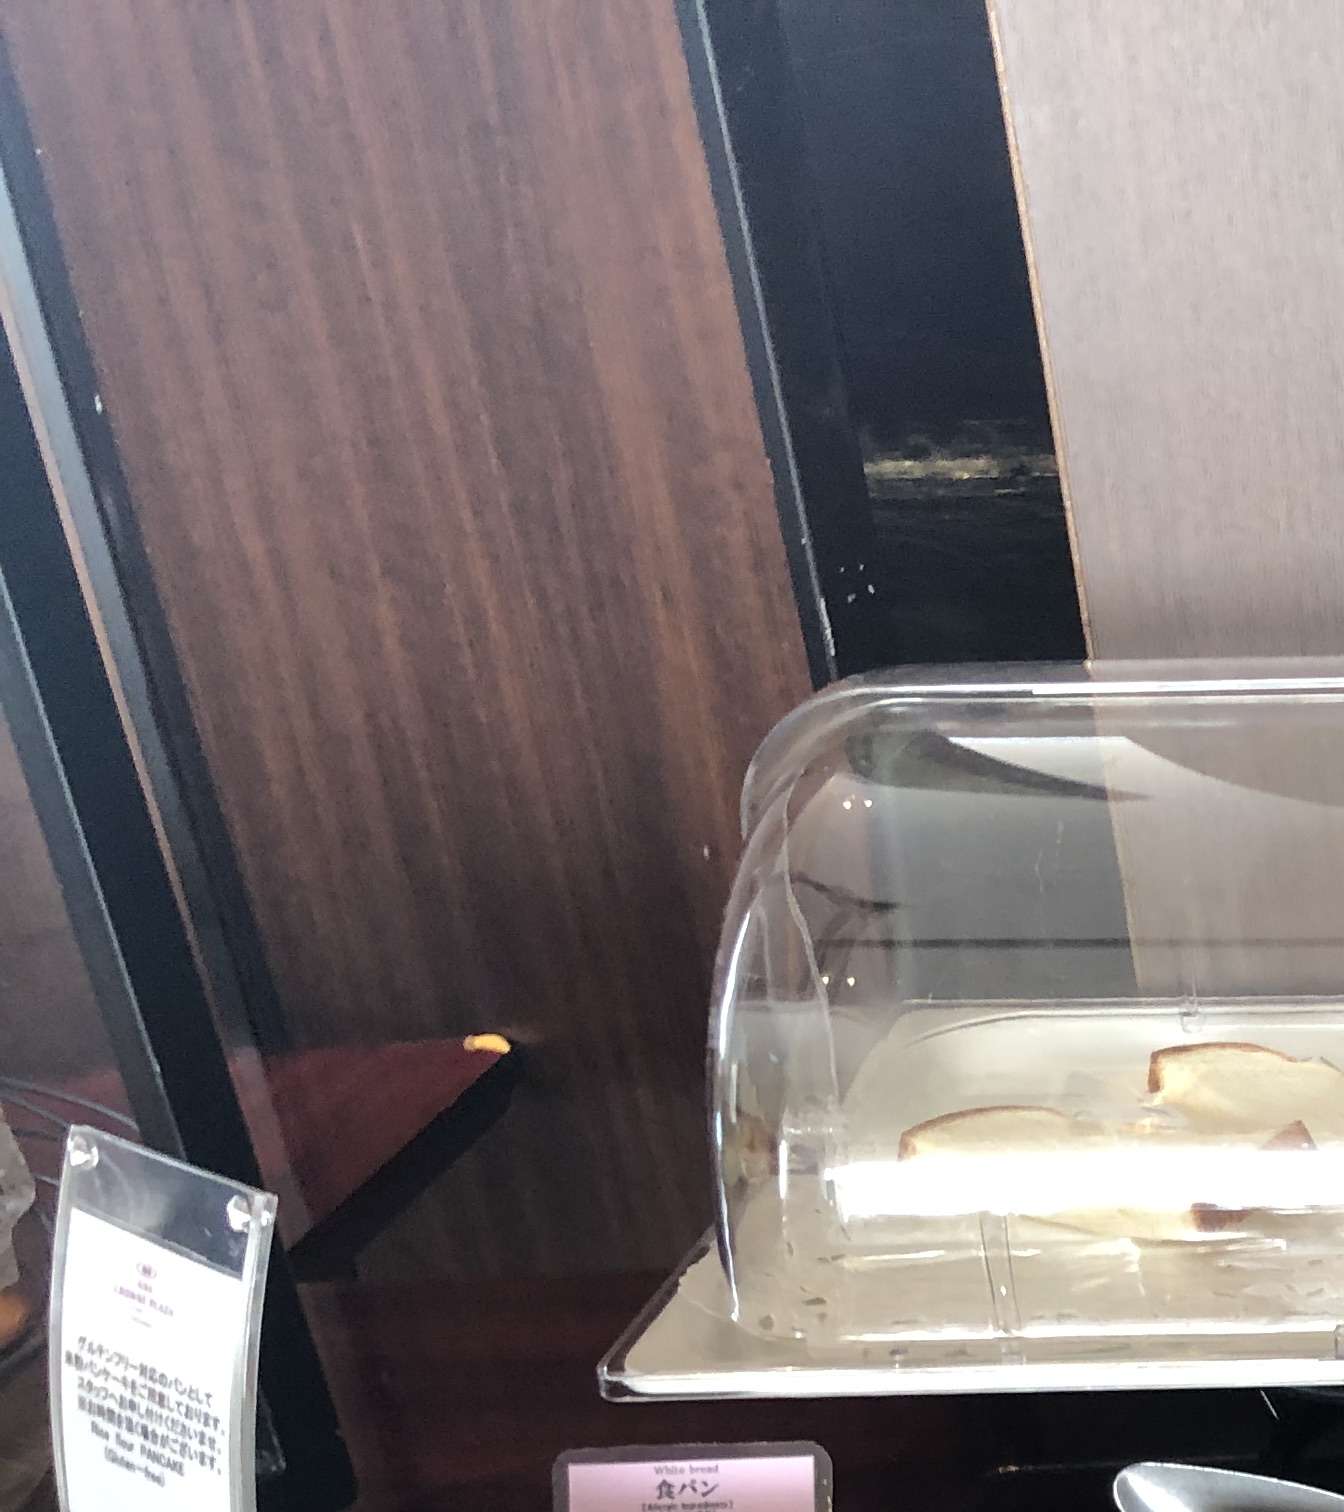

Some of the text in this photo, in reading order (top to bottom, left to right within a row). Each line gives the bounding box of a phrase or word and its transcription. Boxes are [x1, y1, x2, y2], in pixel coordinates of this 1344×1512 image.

[653, 1463, 719, 1475] White bread
[656, 1478, 719, 1500] 食パン
